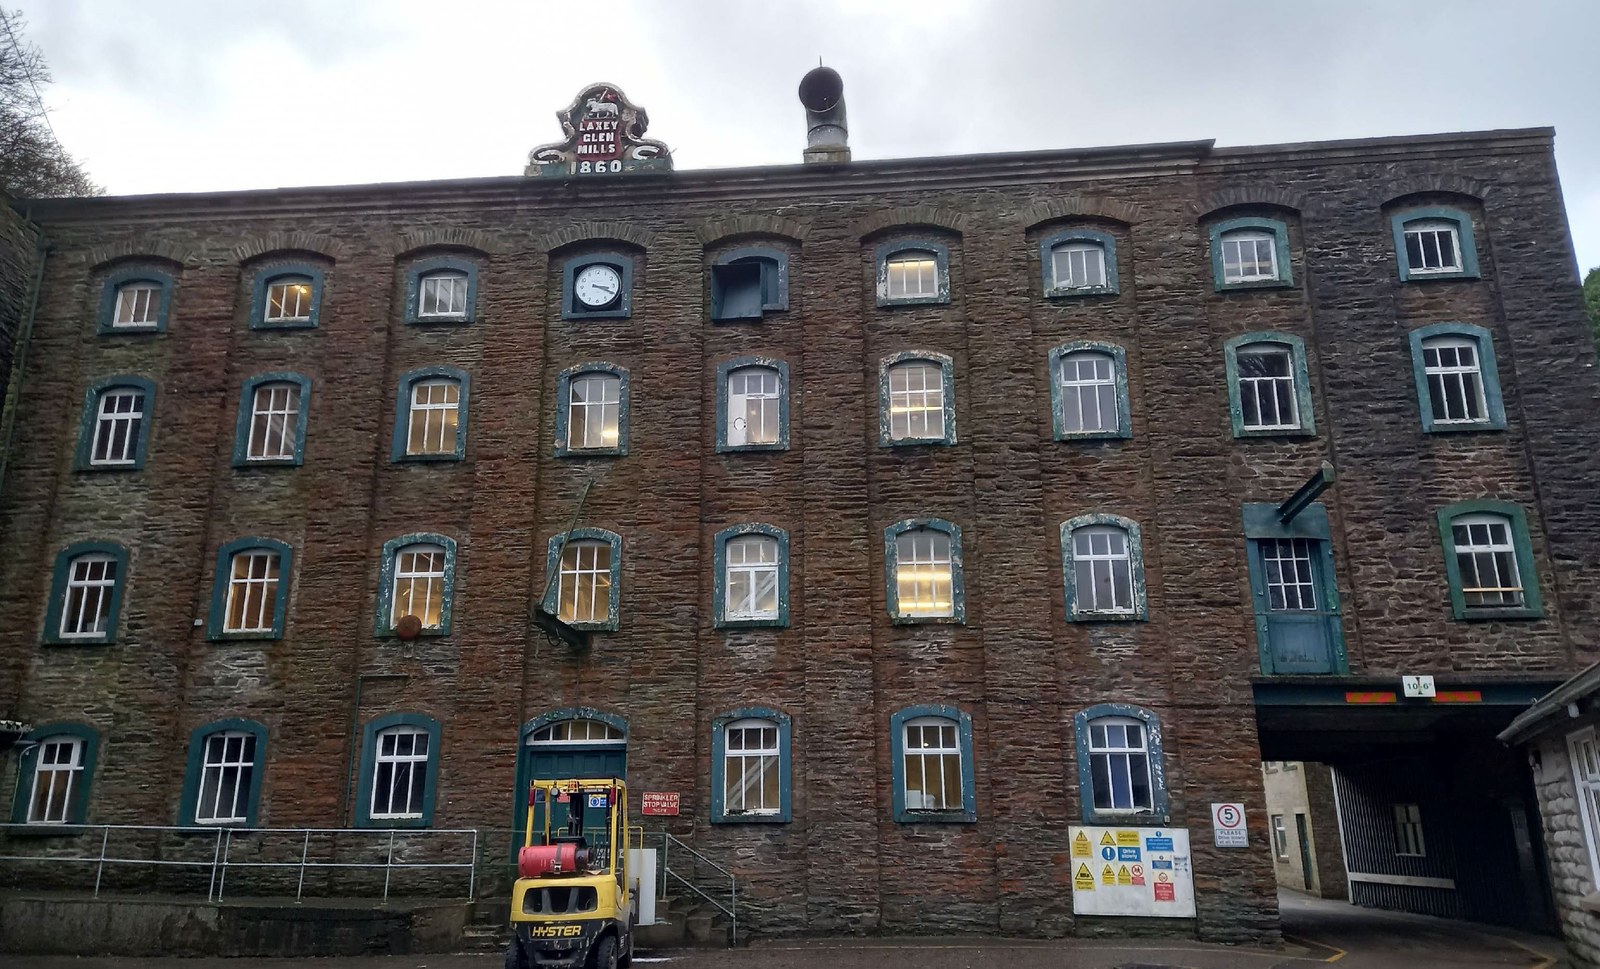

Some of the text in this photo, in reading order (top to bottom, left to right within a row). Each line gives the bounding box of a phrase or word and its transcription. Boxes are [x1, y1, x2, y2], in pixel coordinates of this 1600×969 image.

[579, 121, 618, 131] LAXEY
[583, 132, 614, 142] GLEN
[577, 144, 616, 154] MILLS
[570, 160, 622, 174] 1860
[1224, 809, 1233, 820] 5
[532, 925, 582, 937] HYSTER
